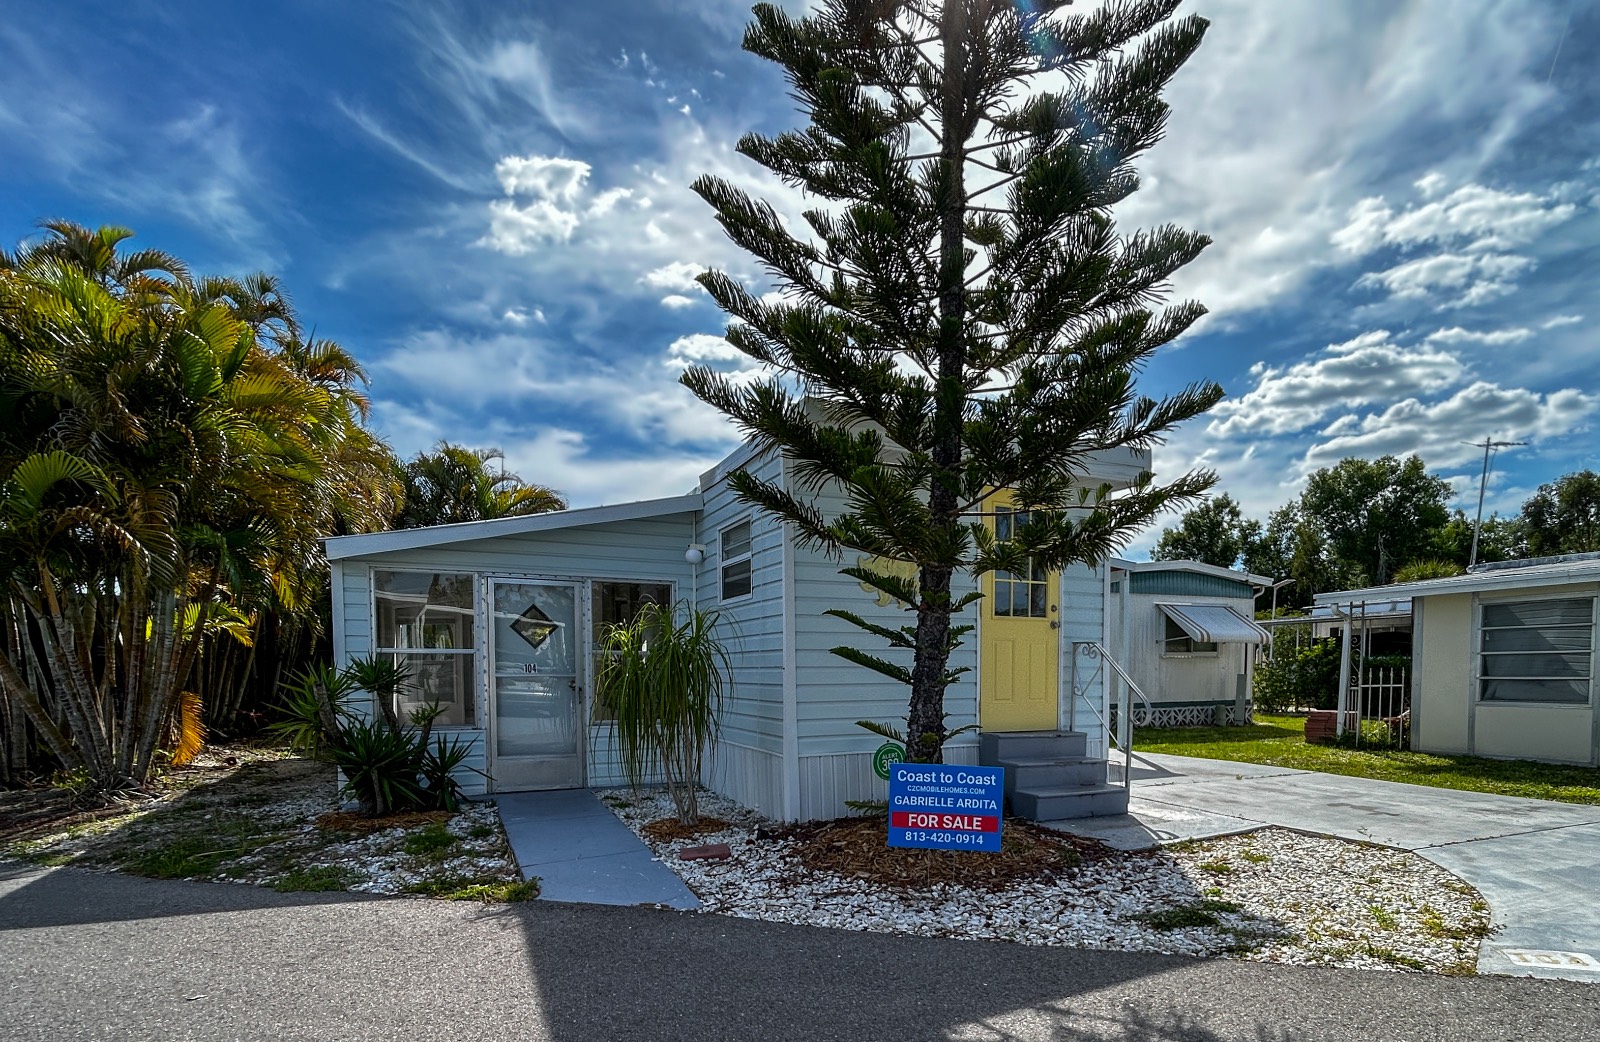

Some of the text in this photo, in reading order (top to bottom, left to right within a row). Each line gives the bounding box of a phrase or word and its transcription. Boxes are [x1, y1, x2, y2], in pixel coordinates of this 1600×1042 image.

[524, 663, 537, 673] 104
[897, 770, 996, 786] Coast to Coast
[907, 785, 985, 795] C2CMOBILEHOMES.COM
[894, 796, 997, 809] GABRIELLE ARDITA
[908, 814, 982, 830] FOR SALE
[905, 831, 983, 844] 813-420-0914
